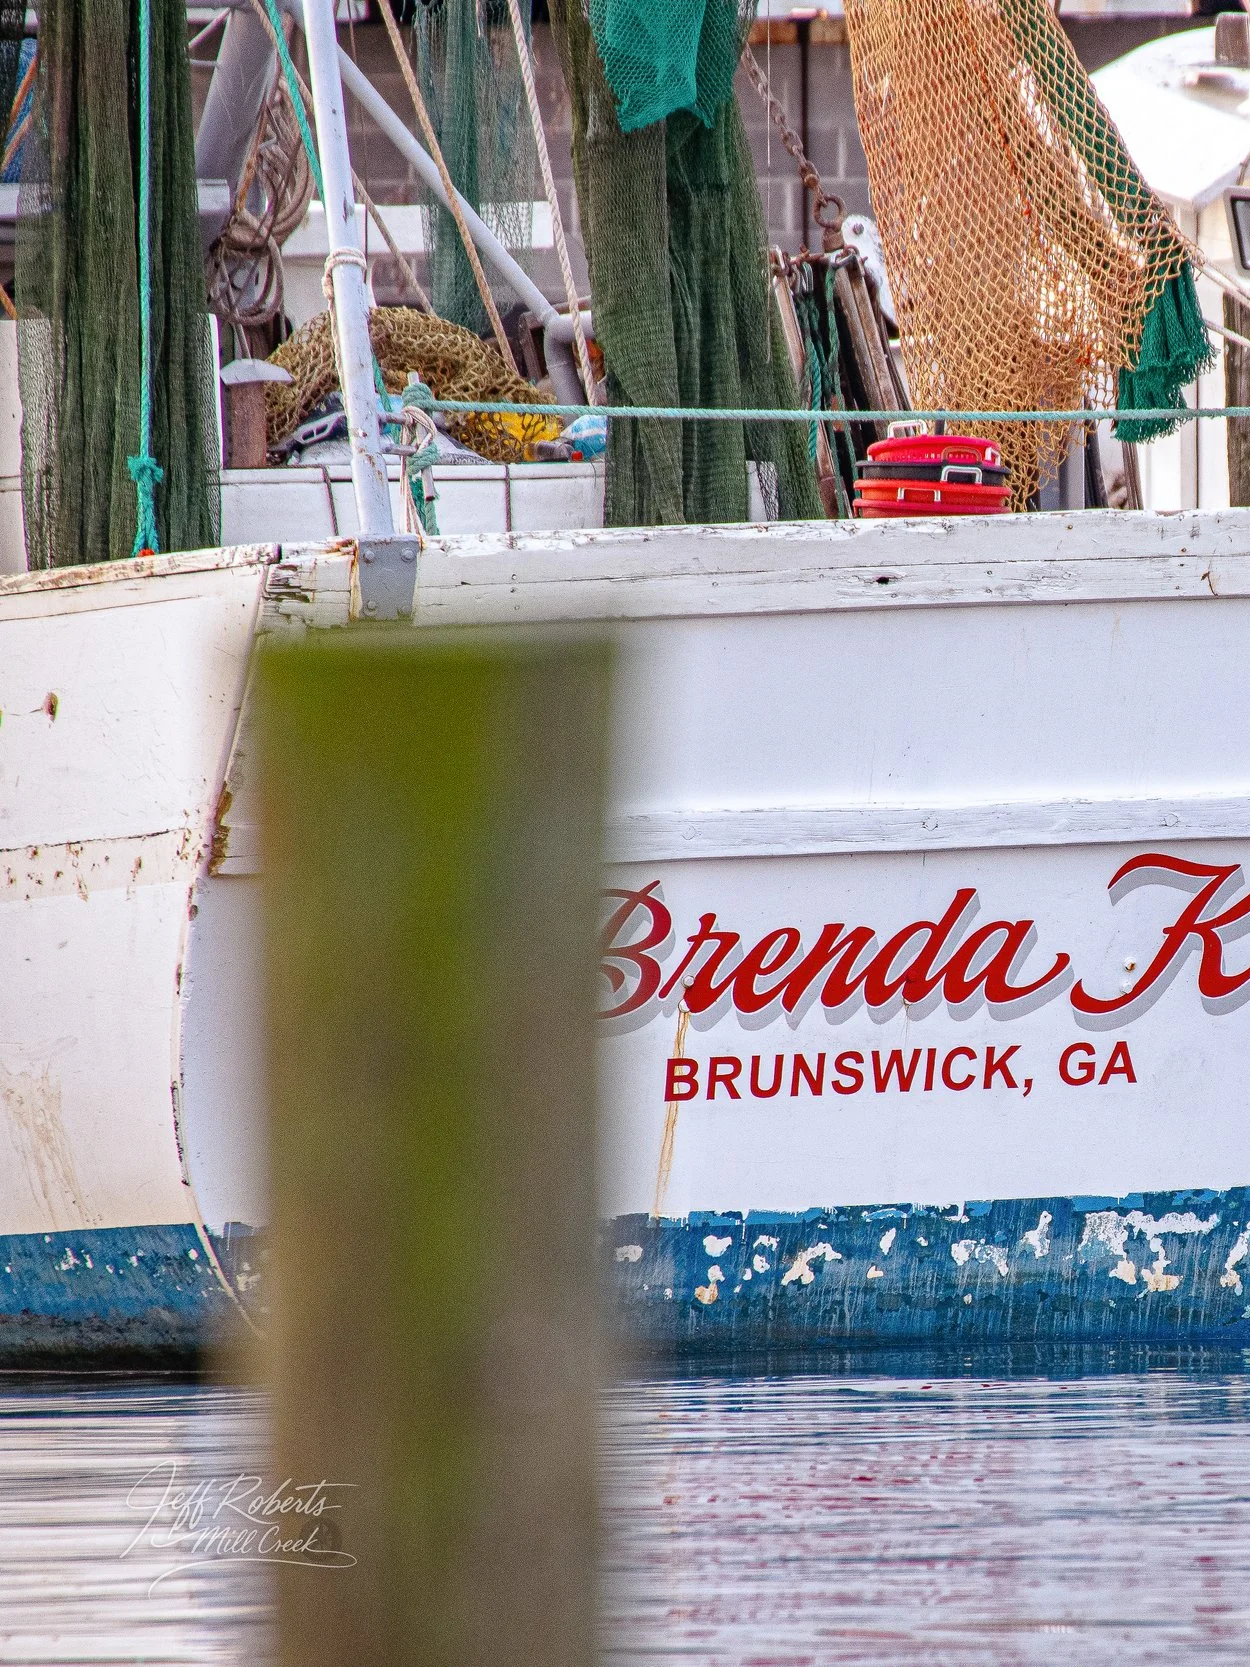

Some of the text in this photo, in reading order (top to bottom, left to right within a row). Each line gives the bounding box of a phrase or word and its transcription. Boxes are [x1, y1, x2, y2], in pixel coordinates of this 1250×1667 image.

[600, 879, 1070, 1018] Brenda
[664, 1040, 1138, 1103] BRUNSWICK, GA
